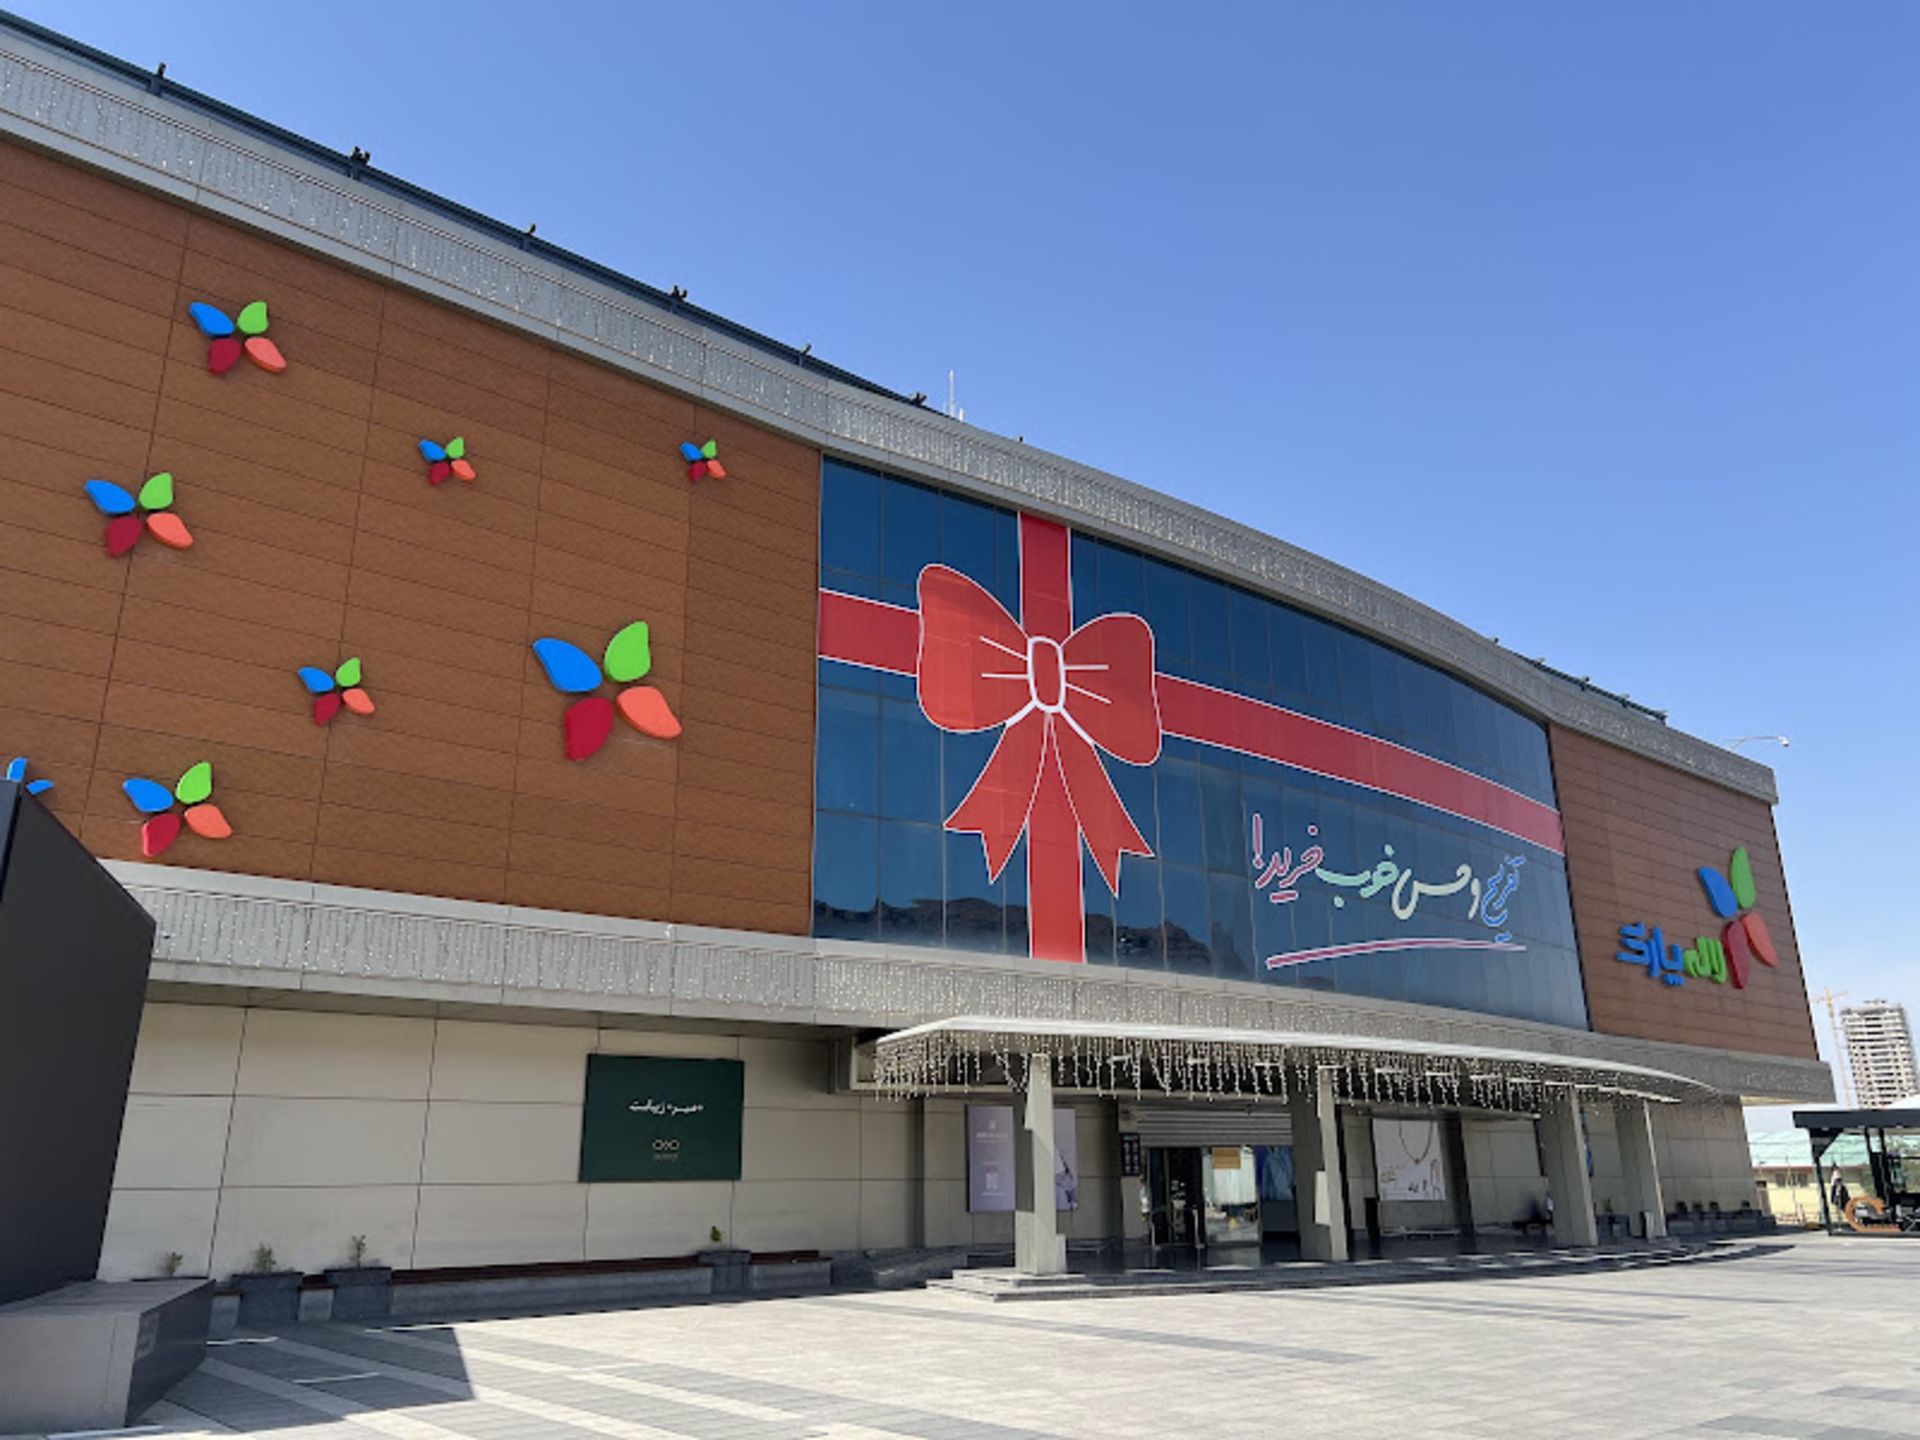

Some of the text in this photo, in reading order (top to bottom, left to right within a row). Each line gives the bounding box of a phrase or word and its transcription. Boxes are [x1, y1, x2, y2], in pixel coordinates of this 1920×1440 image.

[1254, 813, 1323, 903] خرید!
[1315, 843, 1400, 908] خوب
[1391, 863, 1473, 920] حس
[1615, 921, 1685, 986] پارک
